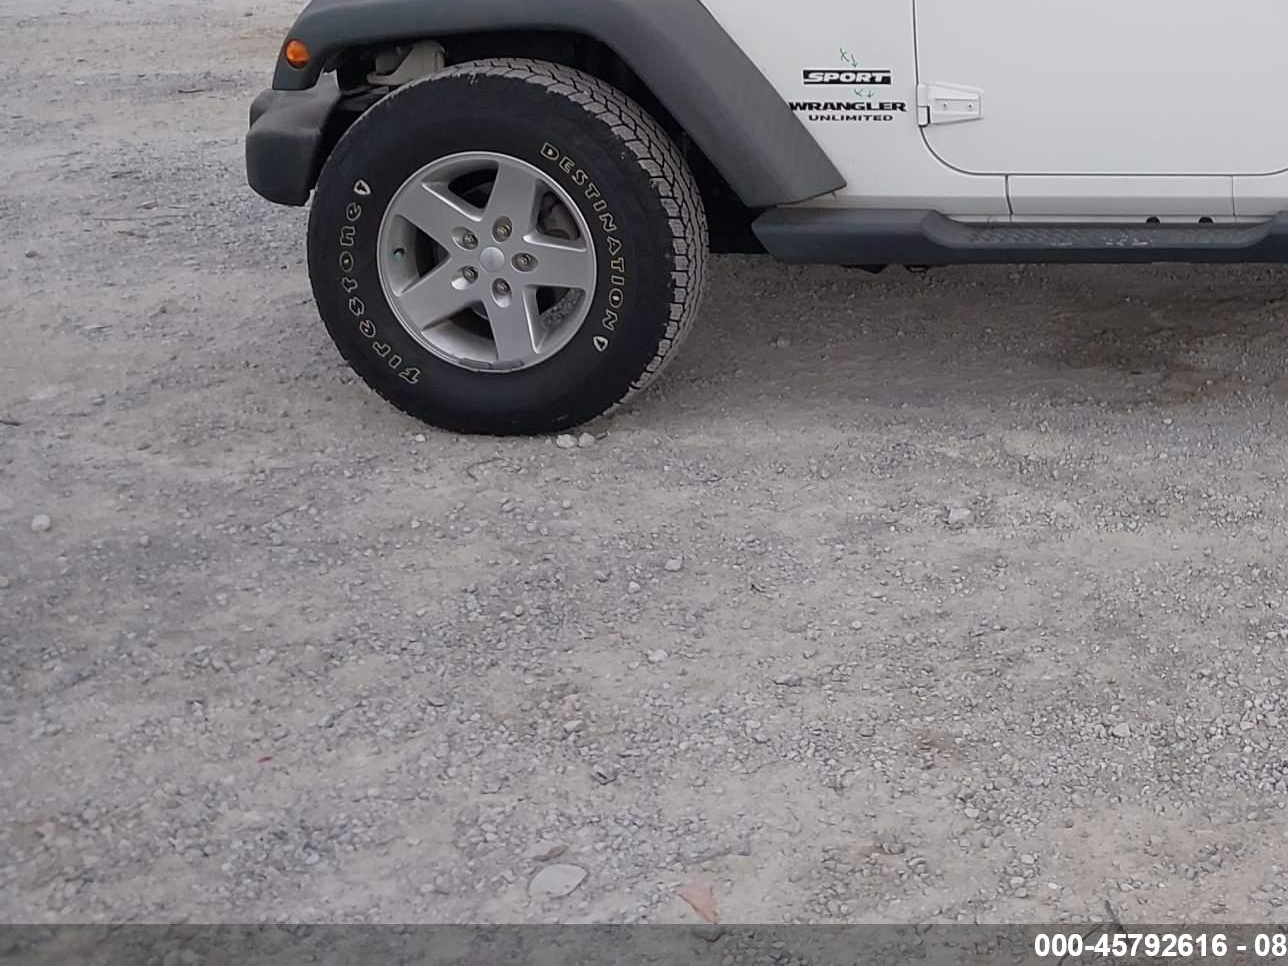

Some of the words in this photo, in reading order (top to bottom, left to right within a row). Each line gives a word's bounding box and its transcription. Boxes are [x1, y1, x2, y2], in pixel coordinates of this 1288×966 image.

[804, 71, 891, 83] SPORT
[789, 101, 907, 112] WRANGLER
[540, 142, 625, 332] DESTINATION
